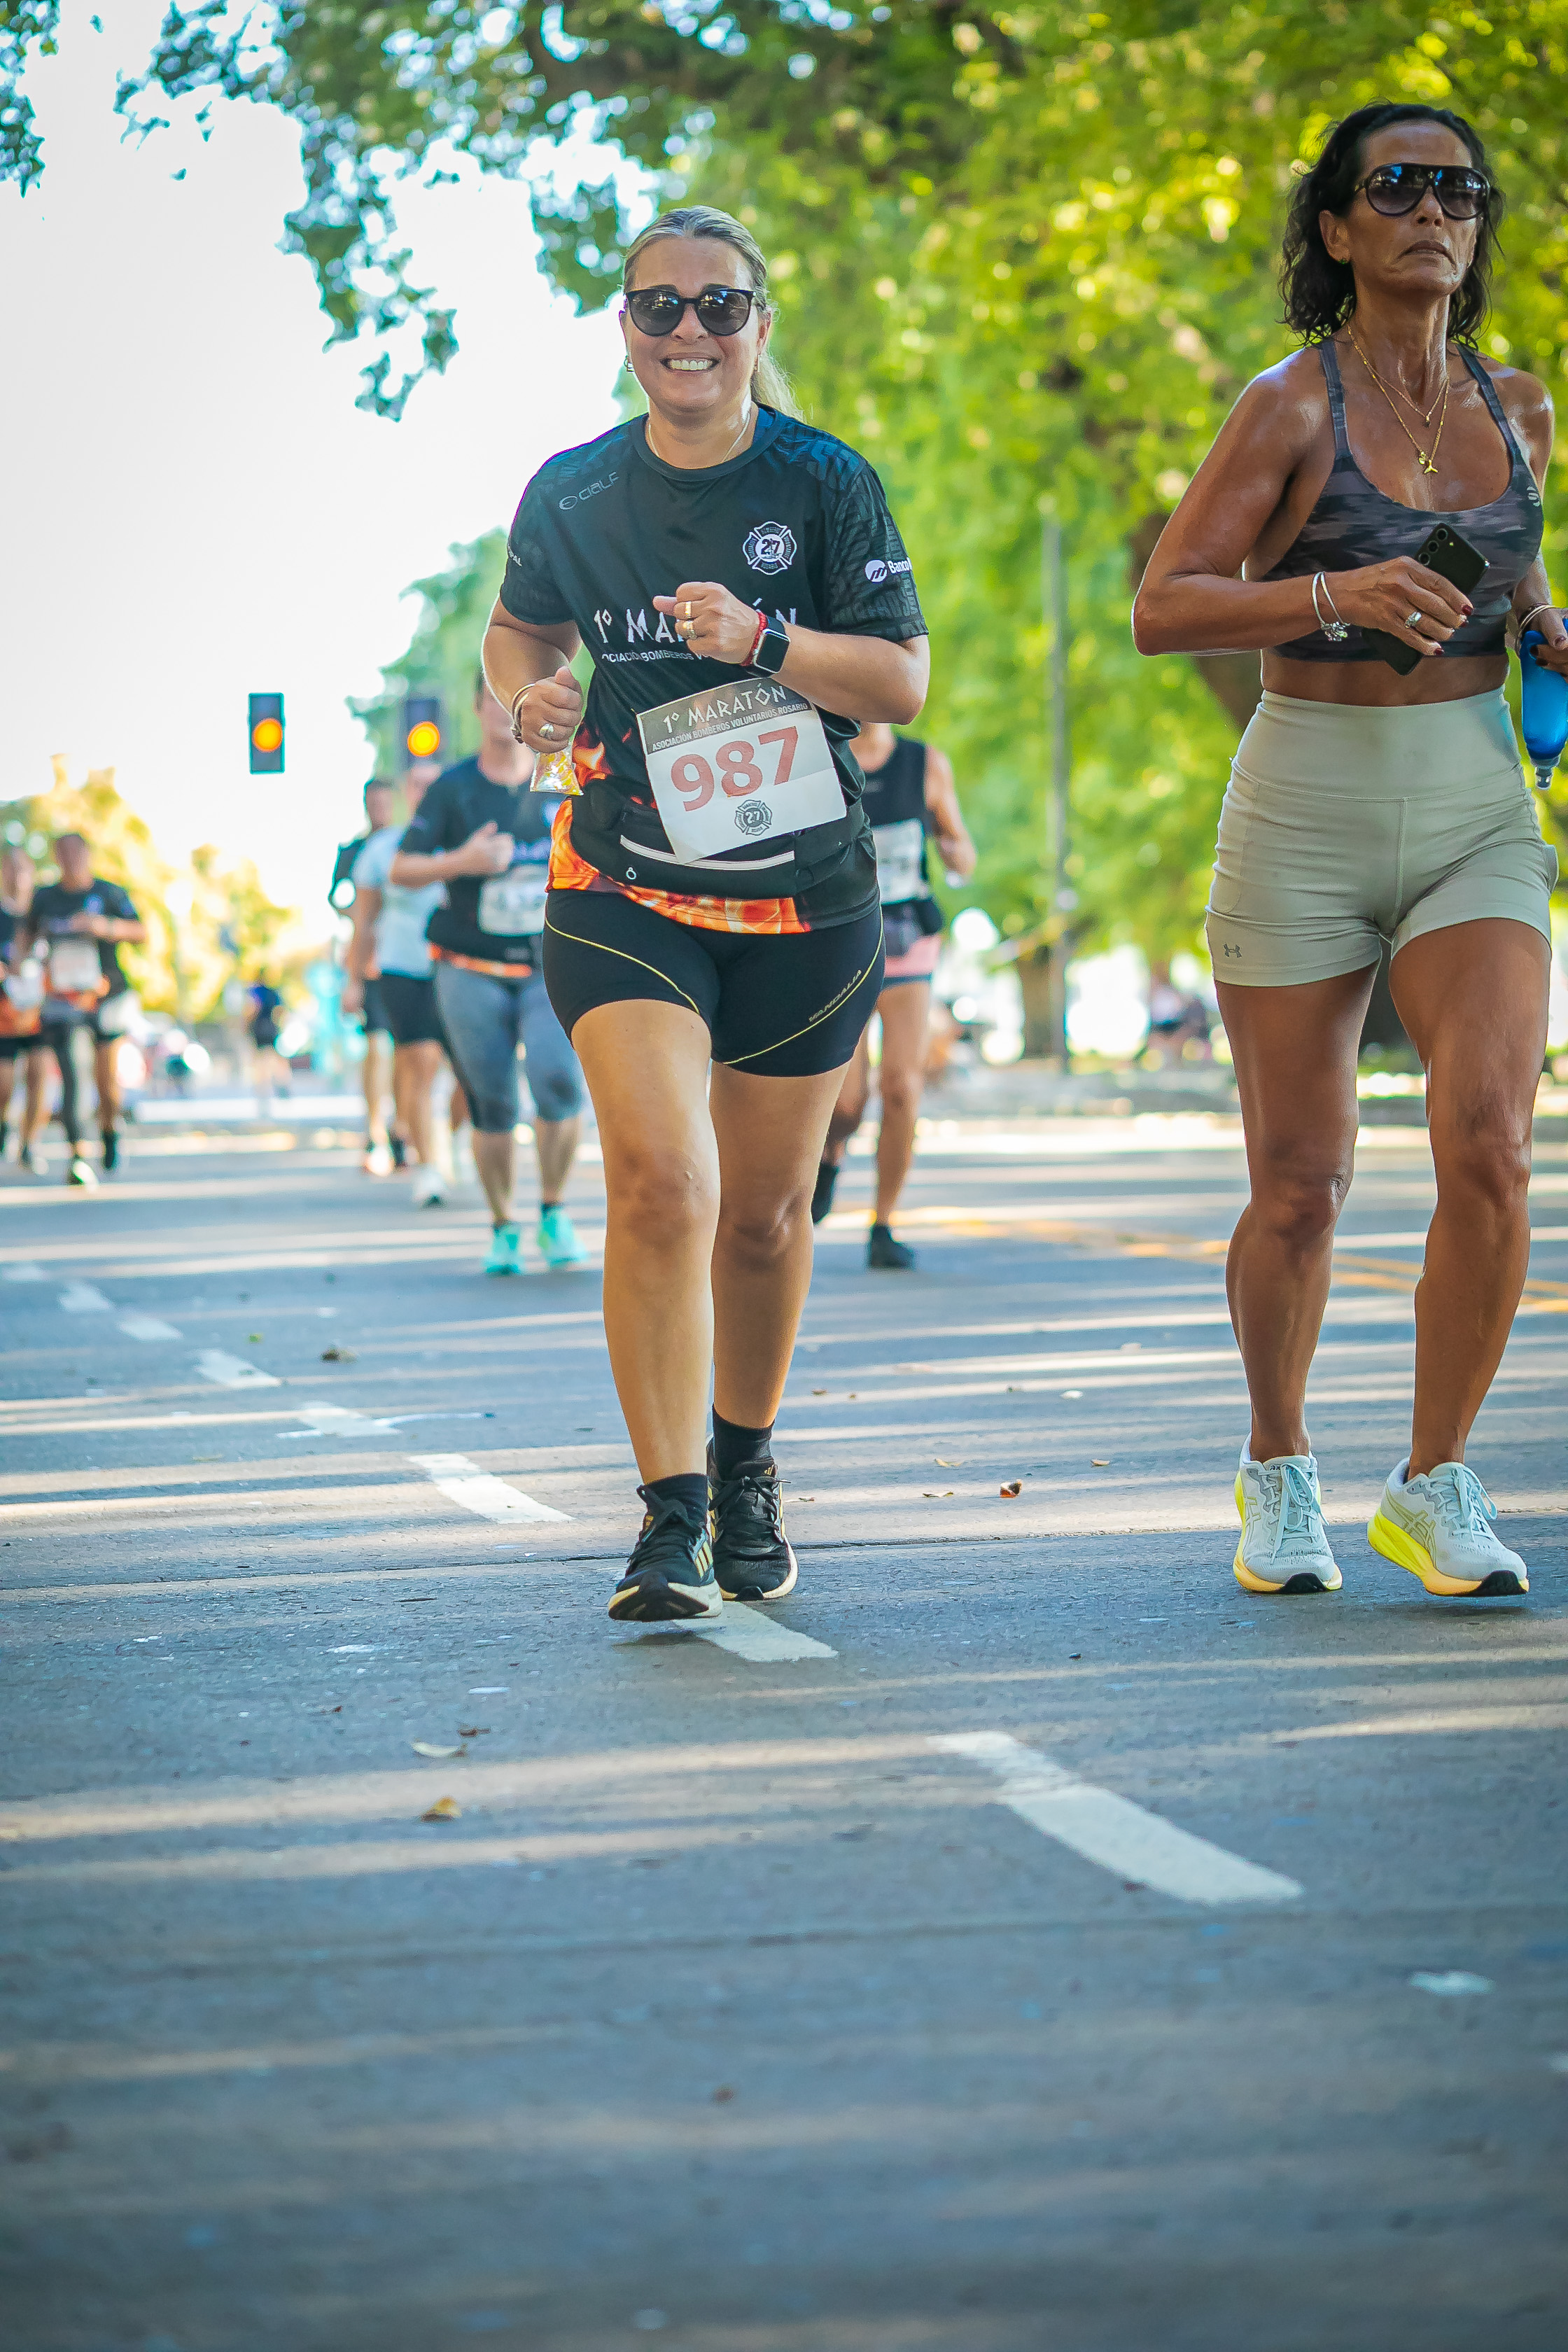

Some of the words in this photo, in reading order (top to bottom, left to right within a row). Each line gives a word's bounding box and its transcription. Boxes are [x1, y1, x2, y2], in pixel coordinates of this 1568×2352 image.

[761, 538, 780, 555] 27
[688, 682, 787, 727] MARATÓN
[692, 722, 731, 739] BOMBEROS
[730, 708, 778, 728] VOLUNTARIOS
[777, 703, 808, 715] ROSARIO
[671, 725, 799, 812] 987
[746, 811, 761, 825] 27
